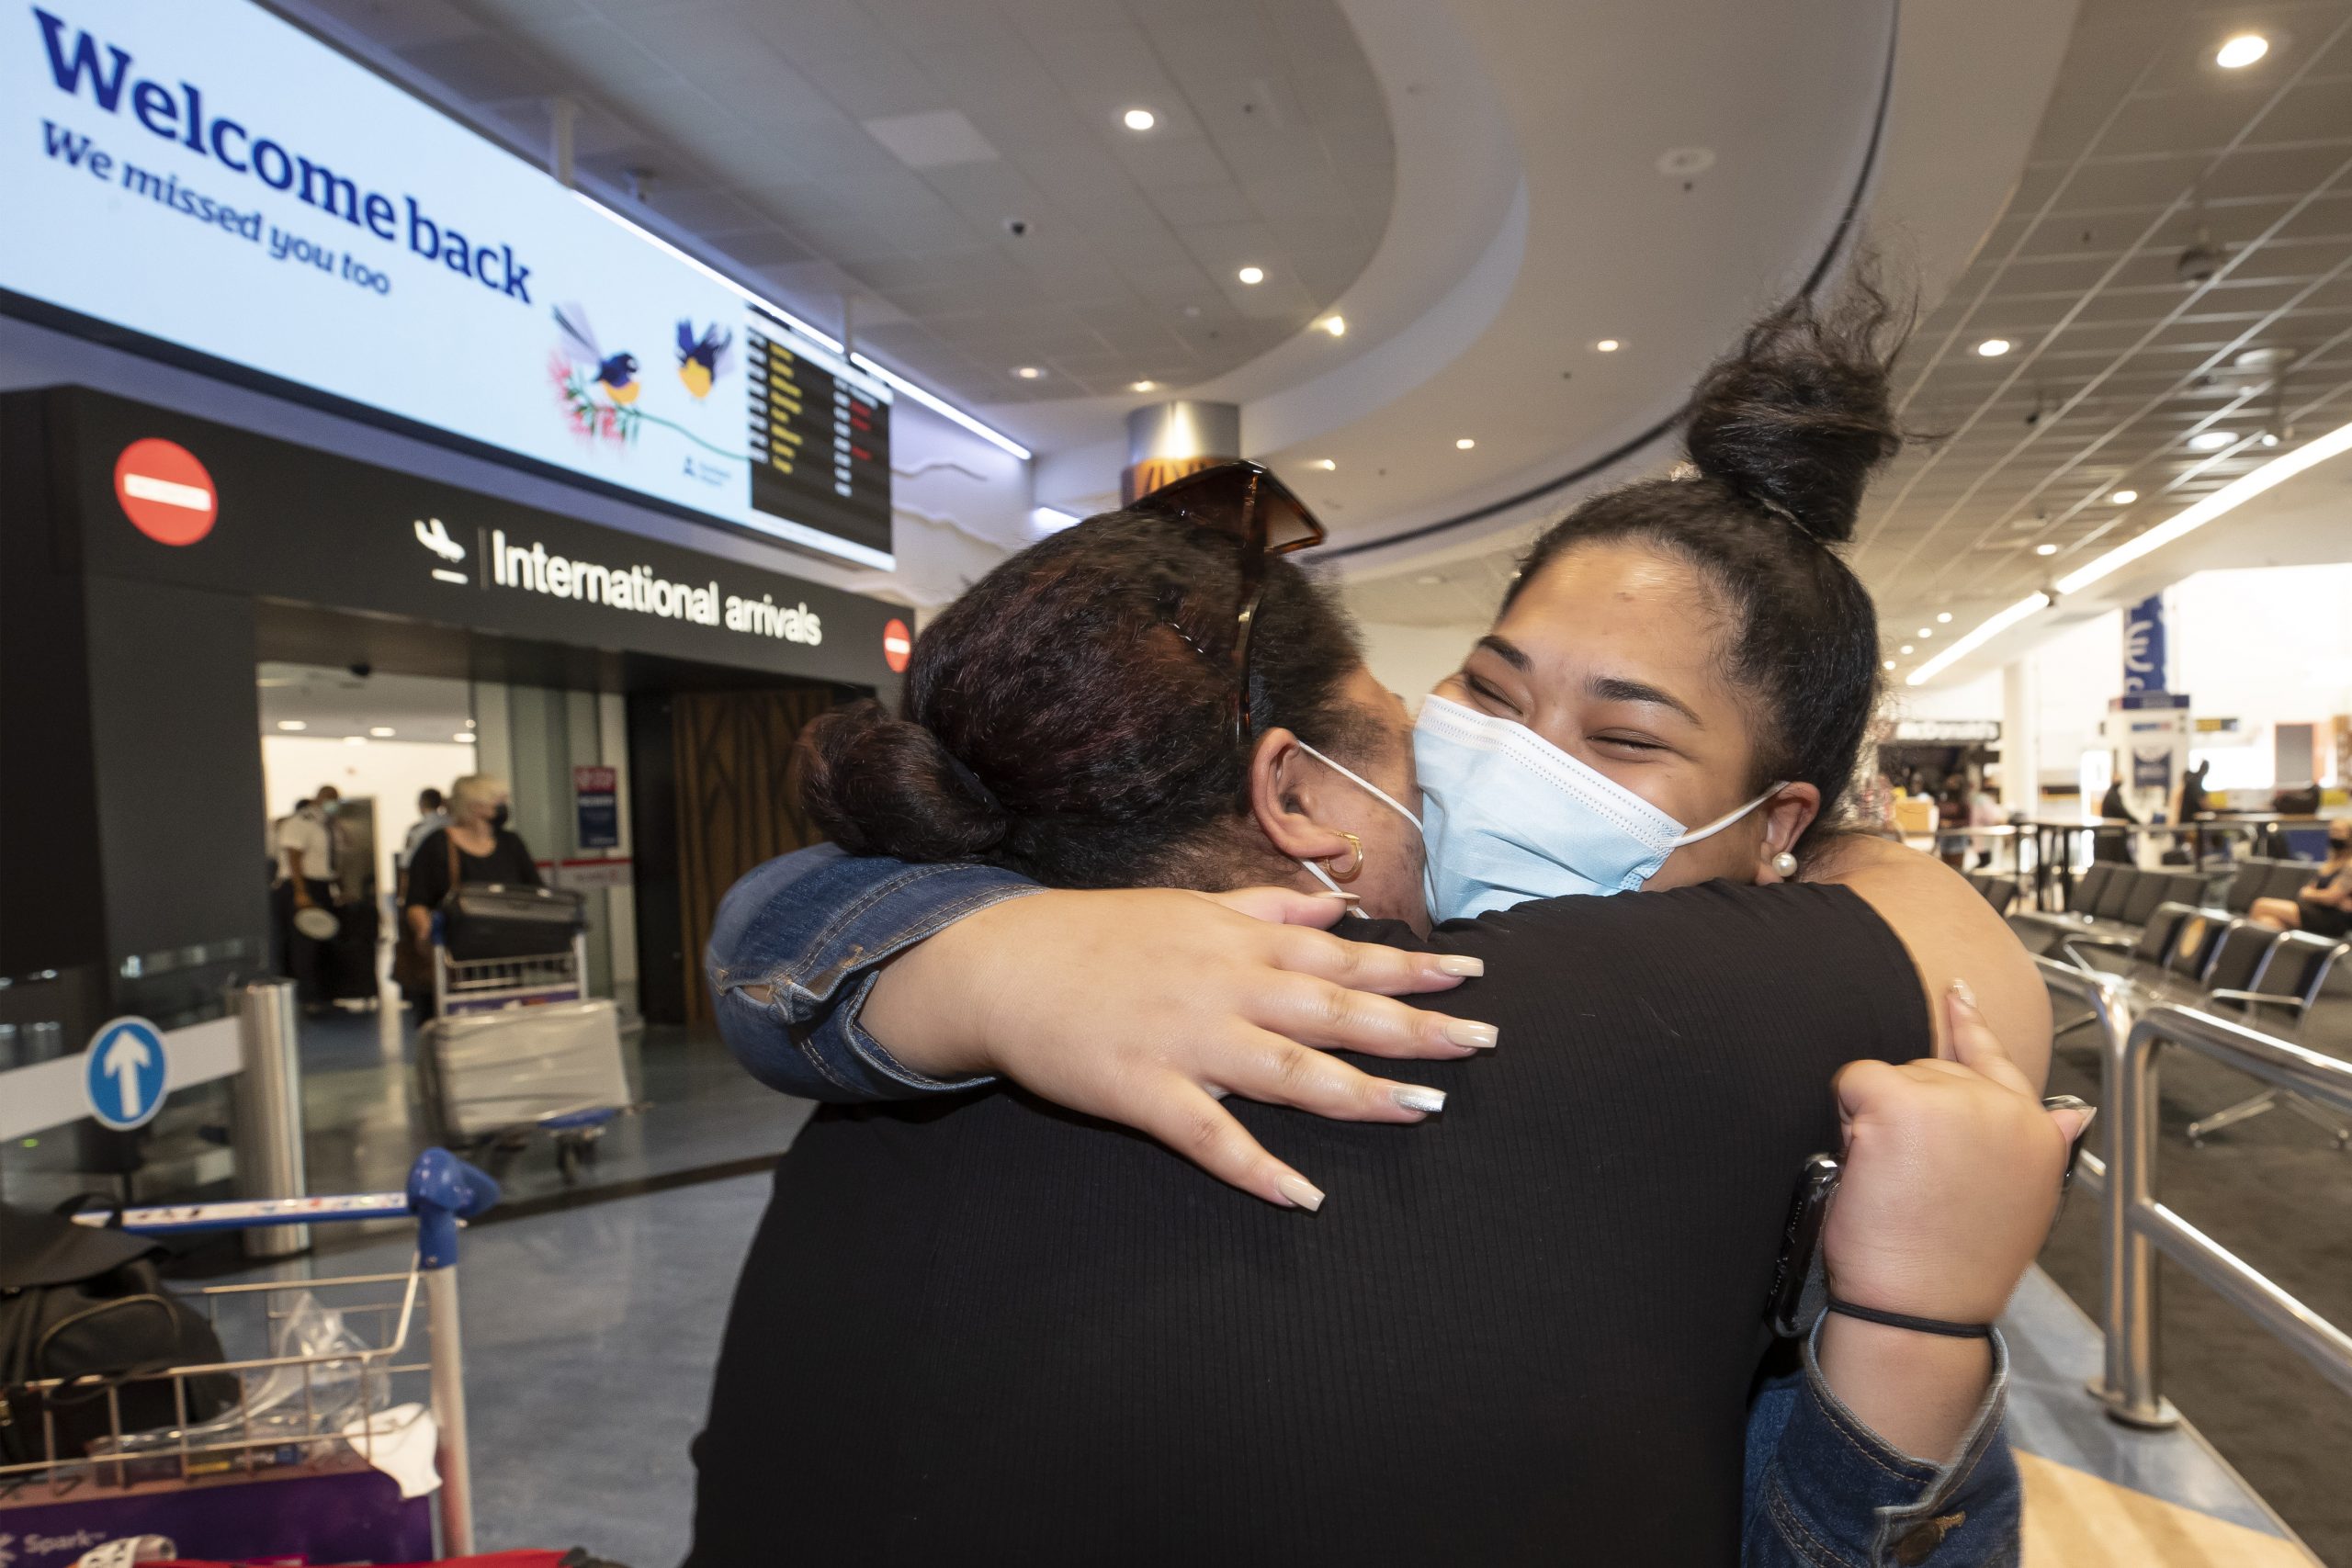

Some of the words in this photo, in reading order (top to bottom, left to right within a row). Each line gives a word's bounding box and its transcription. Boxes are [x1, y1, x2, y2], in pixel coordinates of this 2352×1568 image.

[33, 6, 397, 241] Welcome
[404, 196, 532, 304] back
[41, 118, 114, 180] We
[122, 163, 263, 243] missed
[270, 227, 334, 273] you
[341, 254, 390, 295] too
[493, 530, 719, 626] International
[726, 594, 822, 646] arrivals
